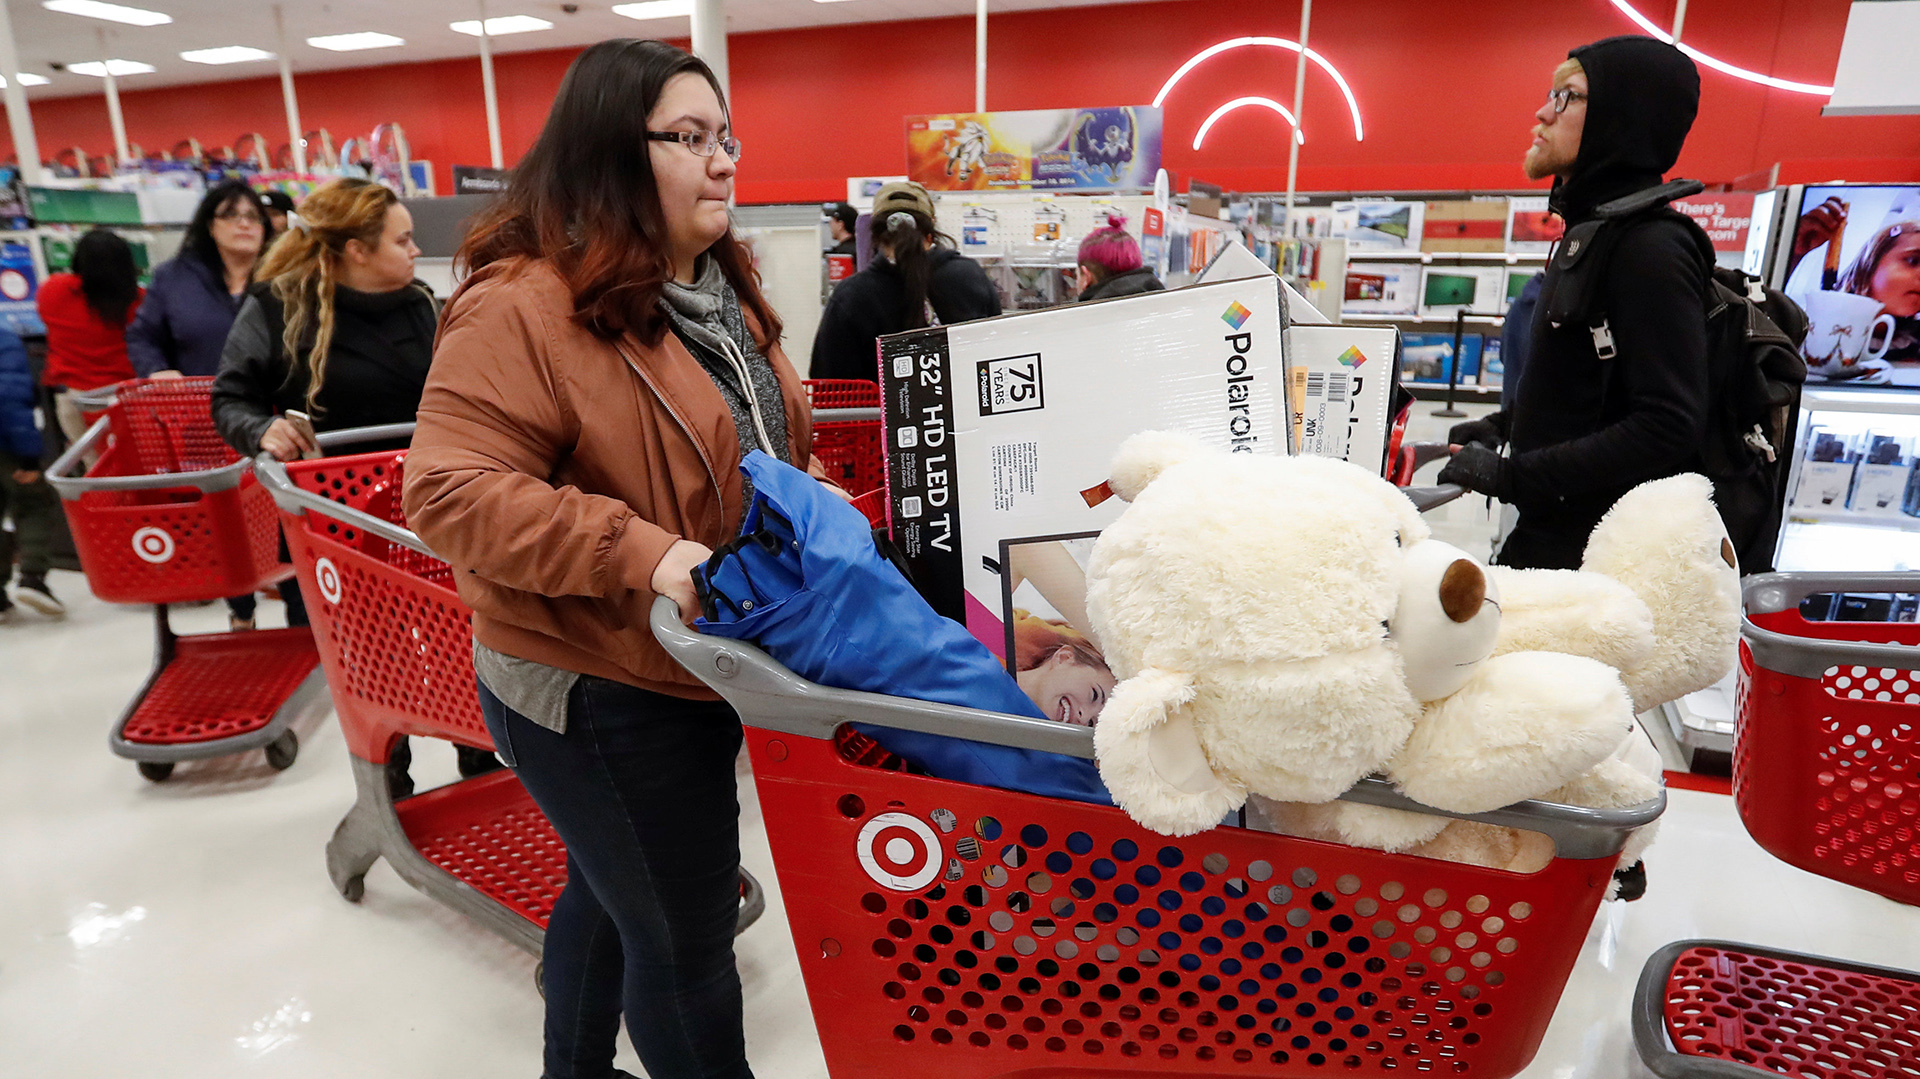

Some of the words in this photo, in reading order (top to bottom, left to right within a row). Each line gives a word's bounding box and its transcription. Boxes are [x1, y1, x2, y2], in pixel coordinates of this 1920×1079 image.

[1675, 201, 1726, 216] There's
[1711, 215, 1750, 232] Targe
[920, 353, 943, 396] 32"
[981, 375, 990, 407] Polaroid
[994, 367, 1005, 405] YEARS
[1009, 364, 1036, 402] 75
[922, 403, 946, 448] HD
[1306, 418, 1317, 437] UNK
[926, 454, 949, 507] LED
[930, 513, 952, 552] TV
